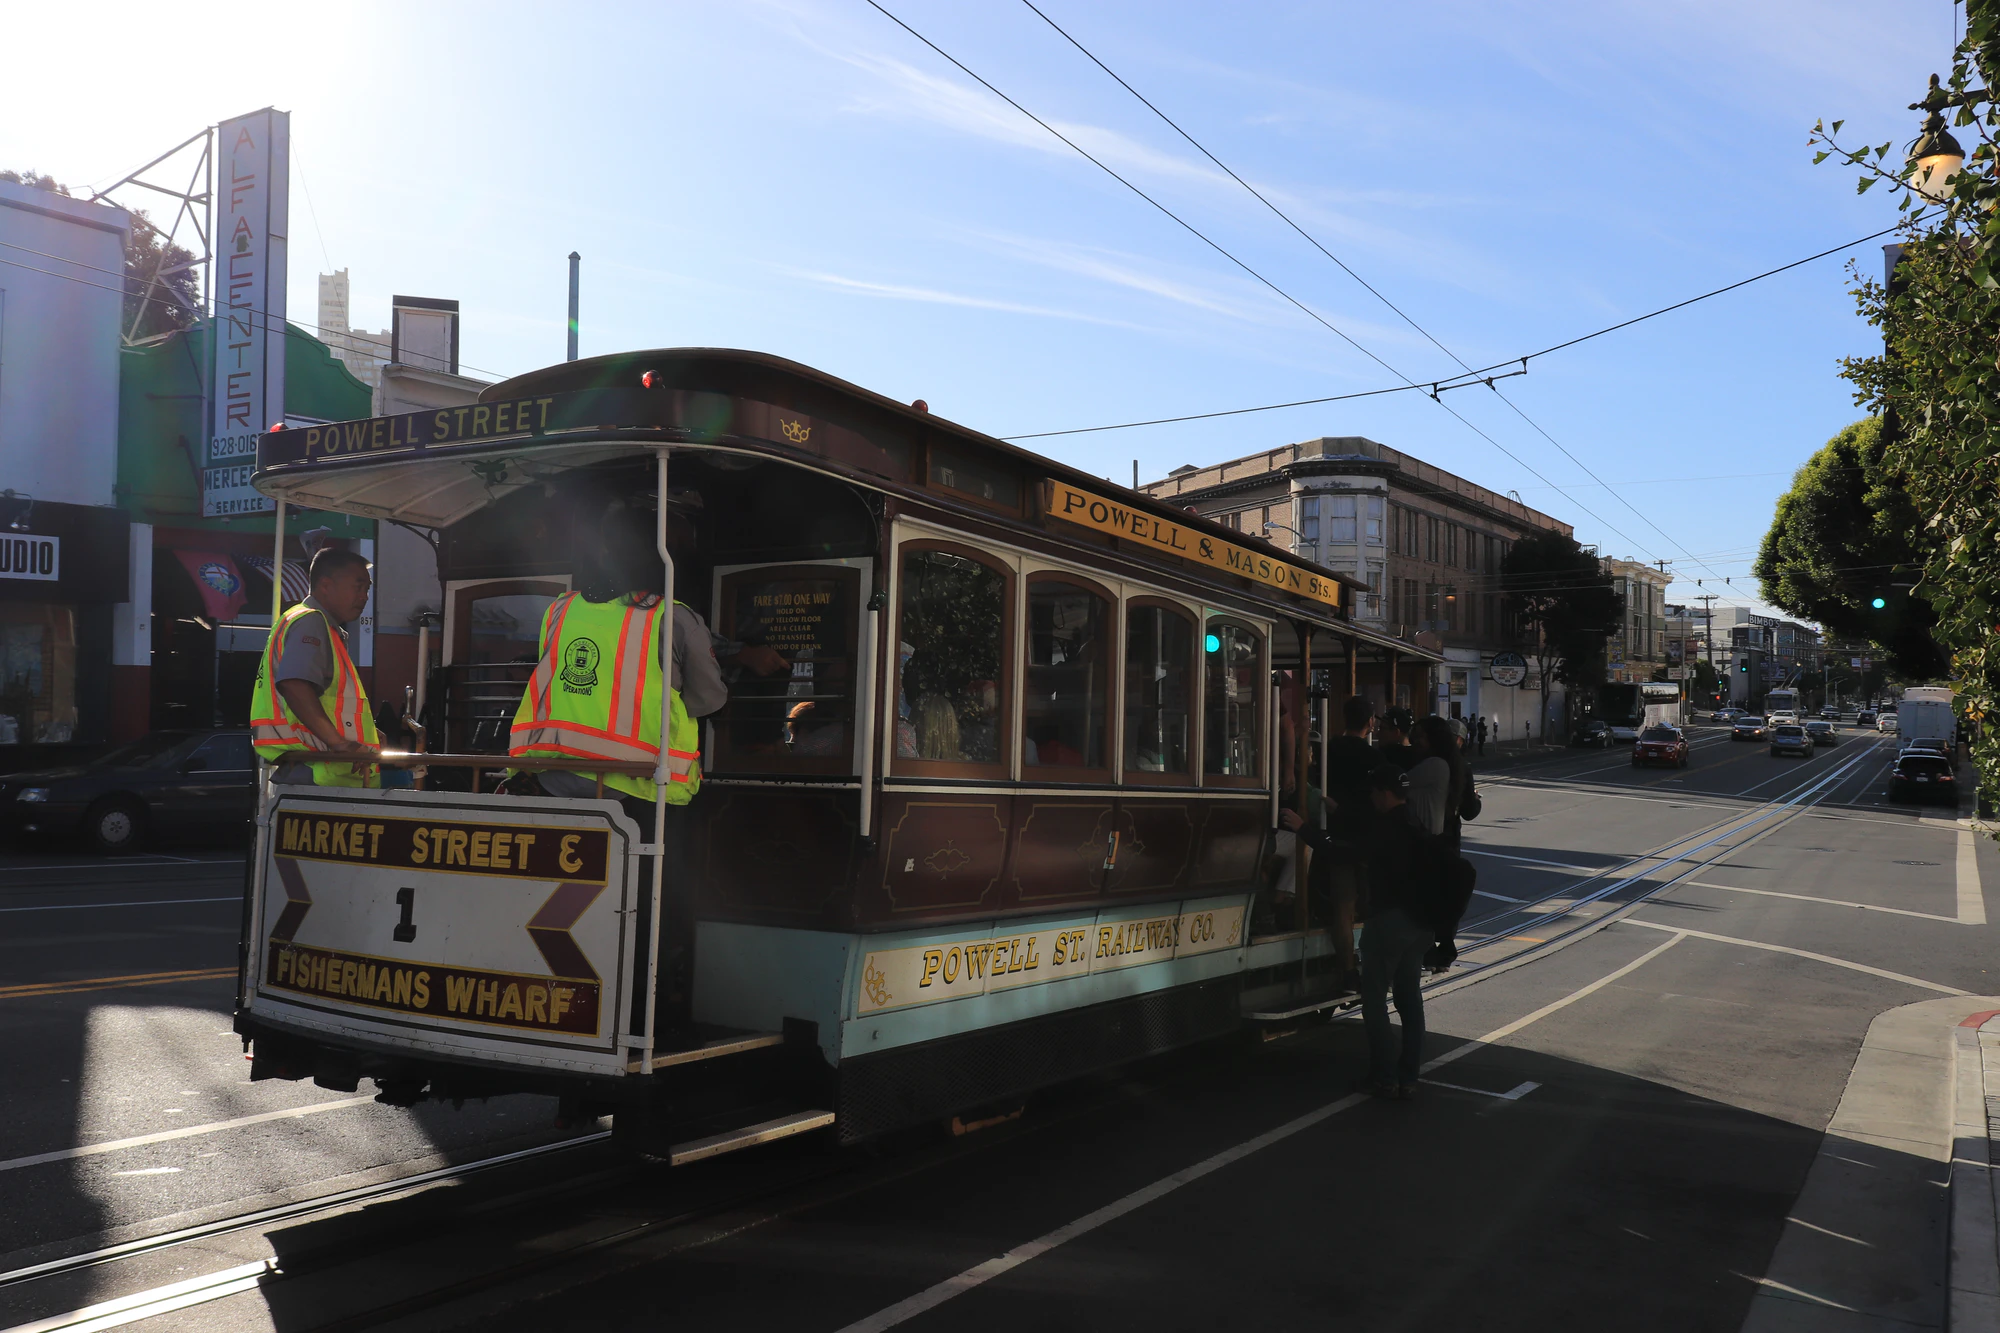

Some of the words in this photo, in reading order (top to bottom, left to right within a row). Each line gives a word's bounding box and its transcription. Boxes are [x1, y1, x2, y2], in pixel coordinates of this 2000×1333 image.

[230, 125, 255, 243] ALFA
[227, 252, 253, 430] CENTER
[306, 415, 419, 456] POWELL
[433, 399, 553, 440] STREET
[216, 497, 263, 514] SERVICE
[0, 538, 53, 575] UDIO
[1063, 490, 1187, 551] POWELL
[1198, 537, 1214, 561] &
[1226, 547, 1301, 589] MASON
[361, 616, 373, 625] 857
[754, 595, 772, 606] FARE
[793, 593, 810, 605] ONE
[813, 592, 831, 604] WAY
[801, 615, 822, 623] FLOOR
[1749, 615, 1780, 629] BIMBO'S
[563, 682, 593, 696] OPERATIONS
[282, 817, 385, 859] MARKET
[411, 827, 536, 870] STREET
[392, 887, 417, 943] 1
[919, 936, 1040, 988] POWELL
[1052, 929, 1086, 966] ST.
[1096, 916, 1185, 959] RAILWAY
[1189, 912, 1216, 944] CO.
[277, 949, 431, 1009] FISHERMANS
[445, 974, 574, 1024] WHARF
